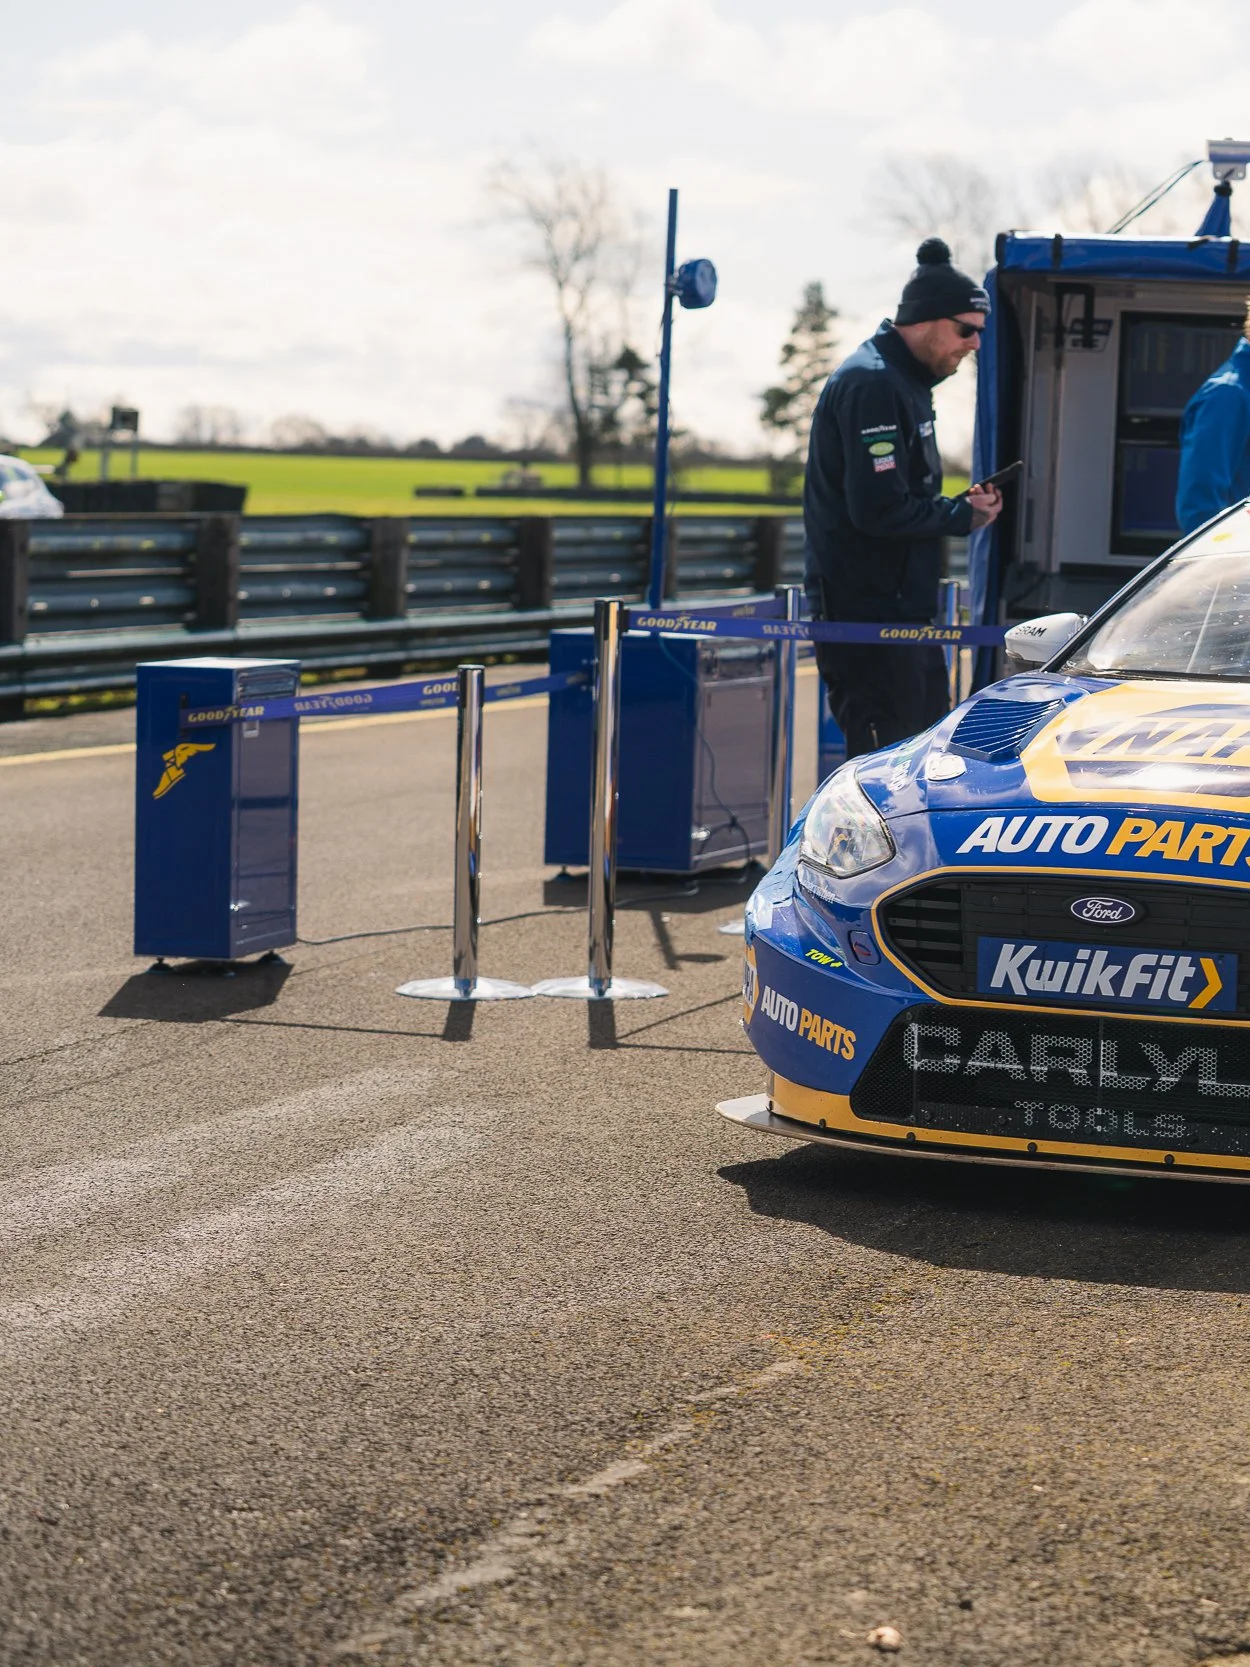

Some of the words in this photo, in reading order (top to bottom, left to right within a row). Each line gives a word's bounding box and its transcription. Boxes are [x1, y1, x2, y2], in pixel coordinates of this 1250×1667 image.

[637, 615, 717, 631] GOODYEAR
[880, 625, 962, 641] GOODYEAR
[188, 704, 264, 723] GOODYEAR
[955, 816, 1109, 854] AUTO
[1082, 899, 1122, 921] Ford
[805, 949, 830, 966] TOW
[761, 985, 799, 1031] AUTO
[798, 1007, 857, 1061] PARTS
[1014, 1100, 1186, 1138] TOOLS
